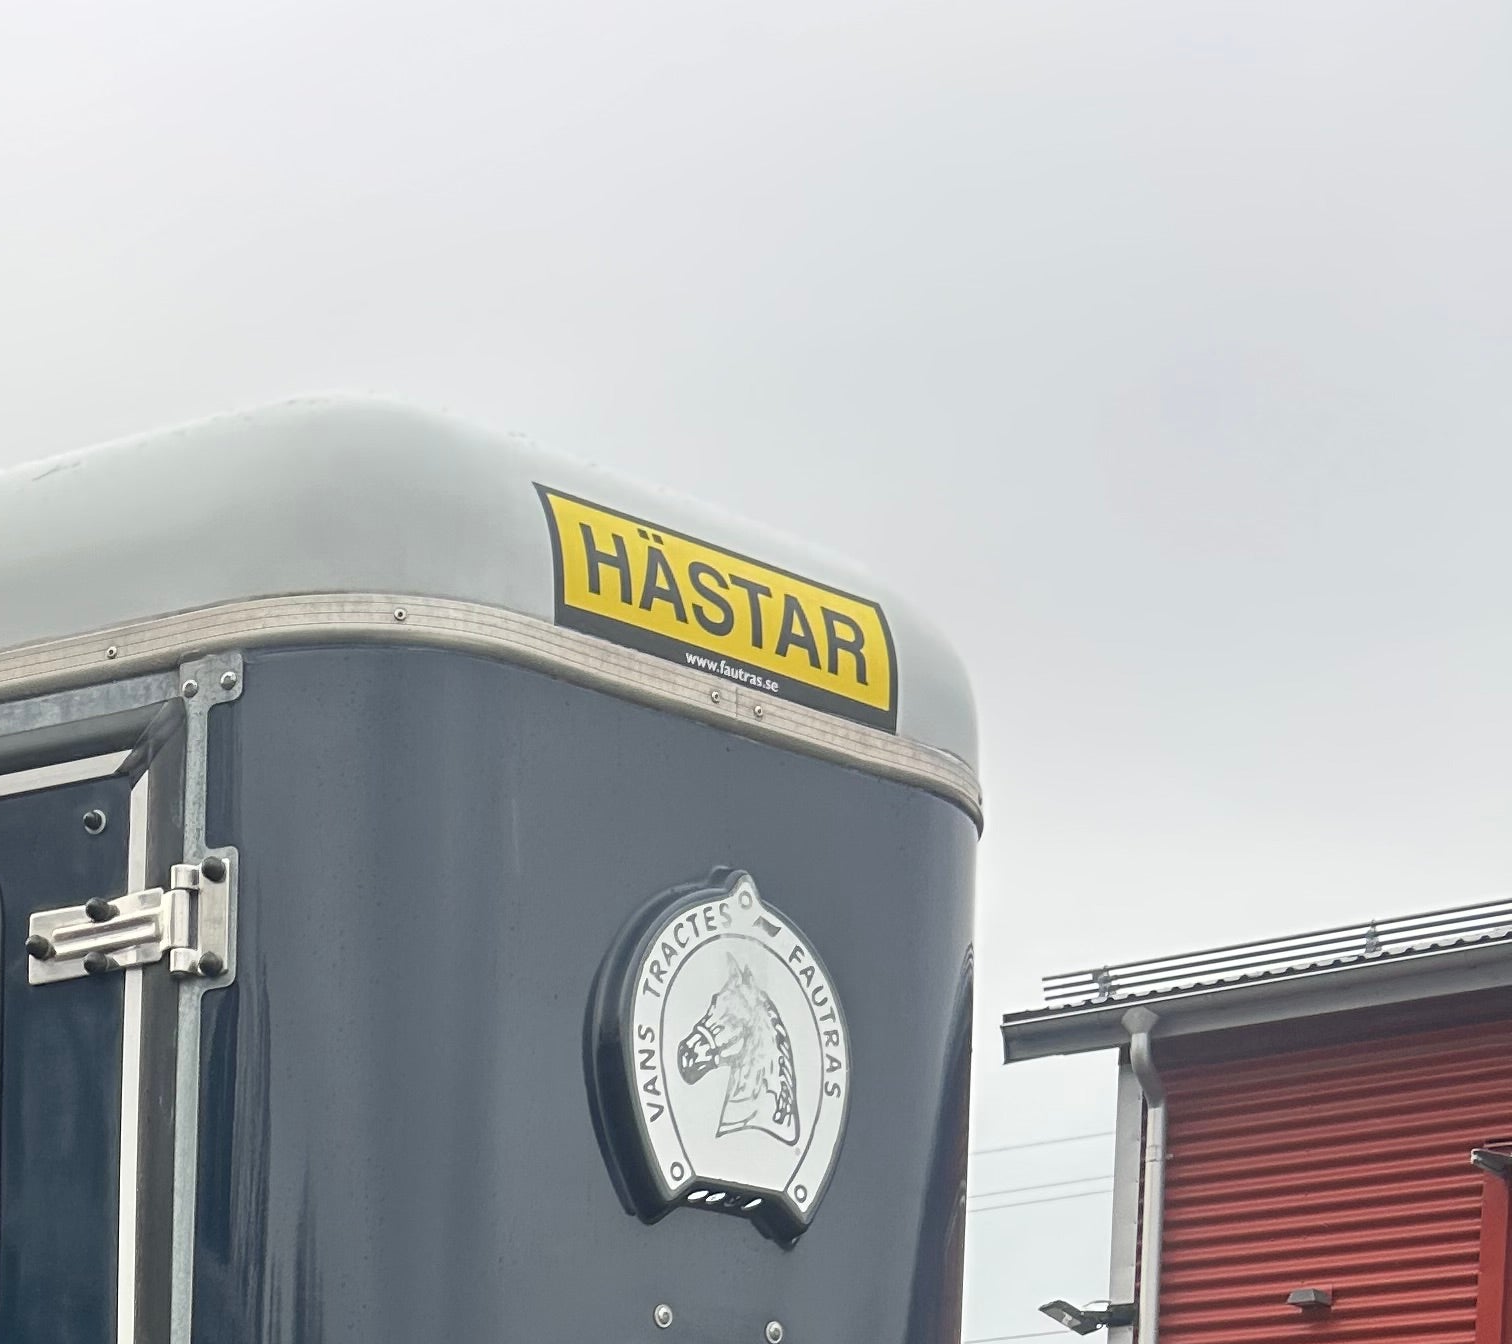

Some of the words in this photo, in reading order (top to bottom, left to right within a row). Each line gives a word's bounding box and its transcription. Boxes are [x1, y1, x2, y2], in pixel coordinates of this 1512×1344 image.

[579, 522, 868, 686] HÄSTAR
[685, 652, 779, 692] www.fautras.se
[642, 902, 733, 998] TRACTES
[788, 945, 843, 1099] FAUTRAS
[637, 1024, 665, 1122] VANS
